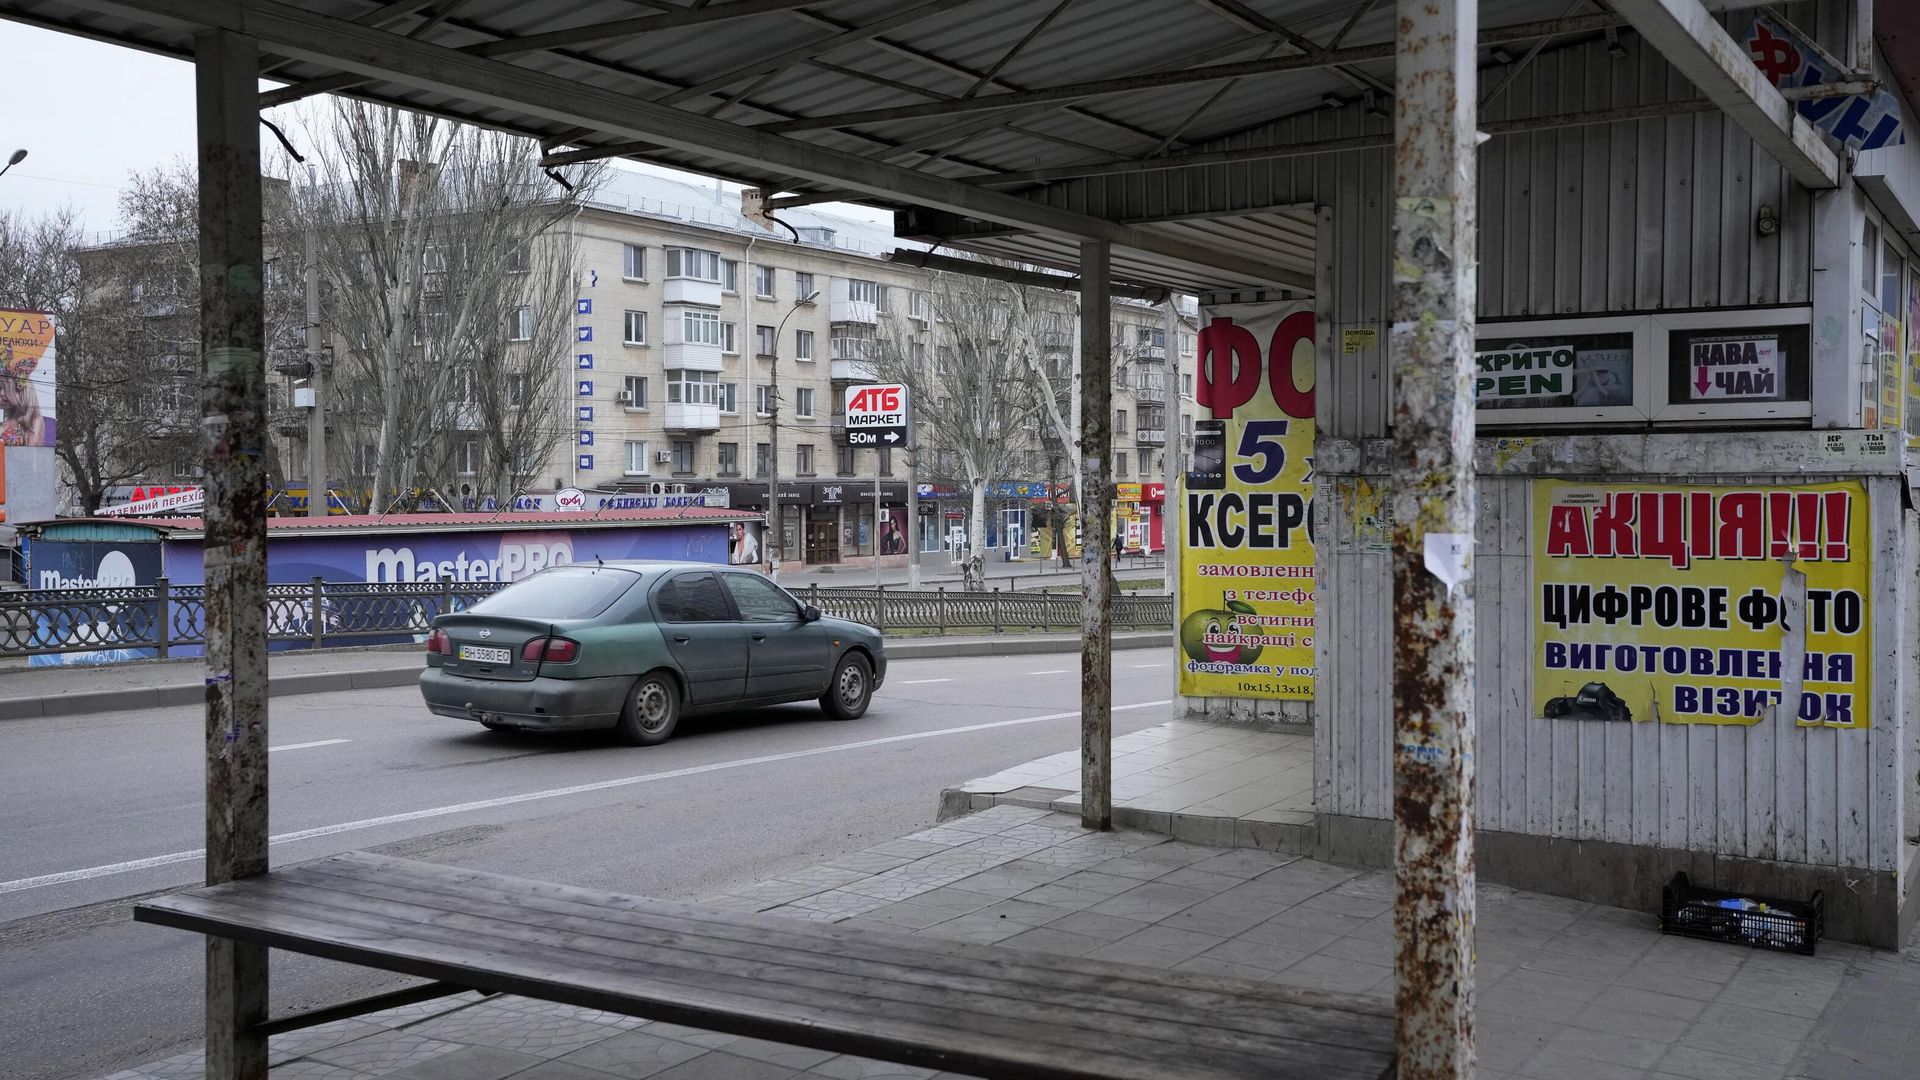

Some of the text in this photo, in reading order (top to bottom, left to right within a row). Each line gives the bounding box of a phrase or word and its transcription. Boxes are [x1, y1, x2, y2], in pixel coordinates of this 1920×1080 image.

[1694, 342, 1759, 367] КАВА
[1715, 368, 1775, 395] ЧАЙ
[848, 387, 902, 412] АТБ
[849, 414, 902, 425] МАРКЕТ
[1233, 421, 1289, 484] 5
[1188, 493, 1315, 548] КСЕР
[1198, 564, 1314, 578] замовленн
[1543, 584, 1861, 634] ЦИФРОВЕ ФТО
[1203, 632, 1296, 648] найкращі
[477, 648, 496, 661] 5580
[1187, 660, 1271, 674] фоторамка
[1276, 668, 1285, 676] у
